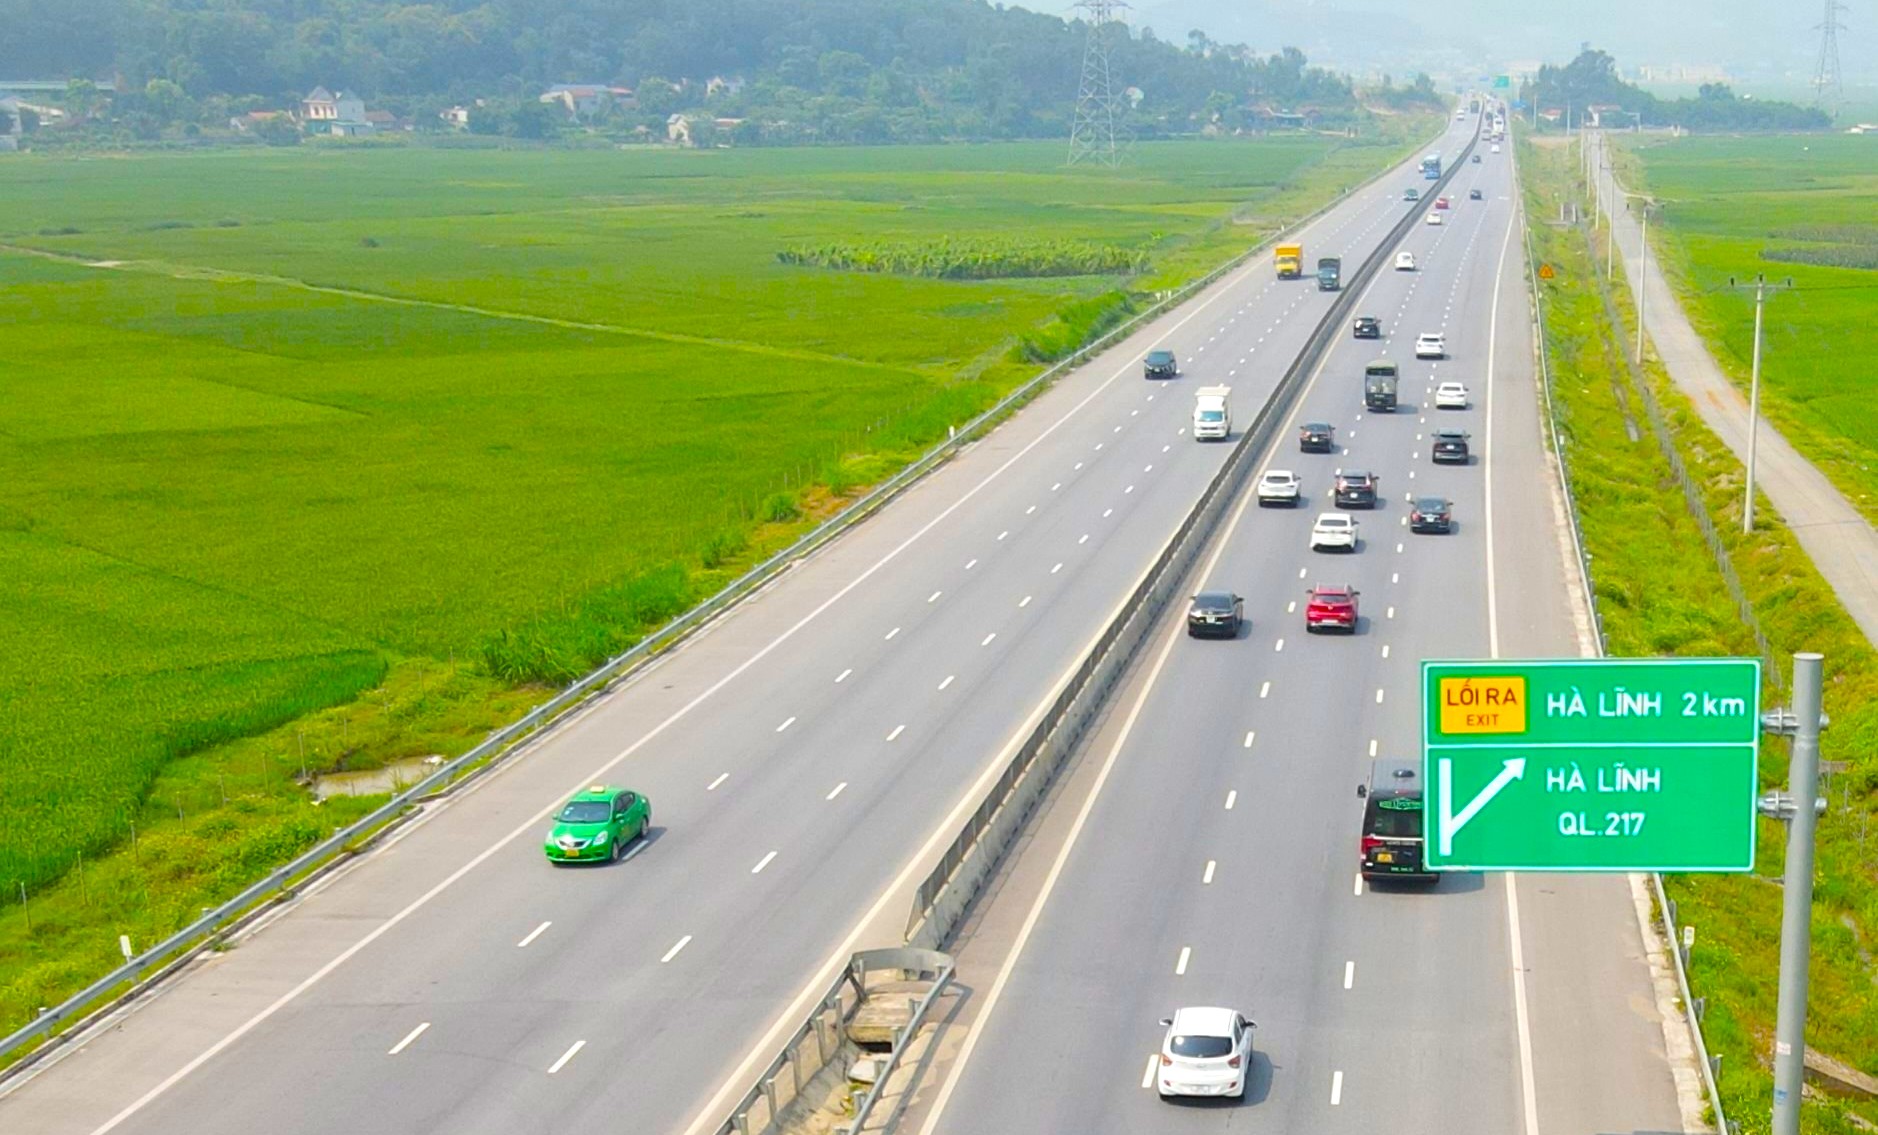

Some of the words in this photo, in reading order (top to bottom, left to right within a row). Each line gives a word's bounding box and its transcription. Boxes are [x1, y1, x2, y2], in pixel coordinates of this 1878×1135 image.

[1447, 679, 1479, 706] LỐI
[1486, 687, 1517, 706] RA
[1547, 686, 1586, 717] HÀ
[1599, 687, 1661, 717] LĨNH
[1682, 692, 1697, 717] 2
[1703, 691, 1745, 717] km
[1466, 714, 1498, 727] EXIT
[1546, 762, 1586, 793] HÀ
[1598, 763, 1660, 793] LĨNH
[1558, 811, 1645, 836] QL.217
